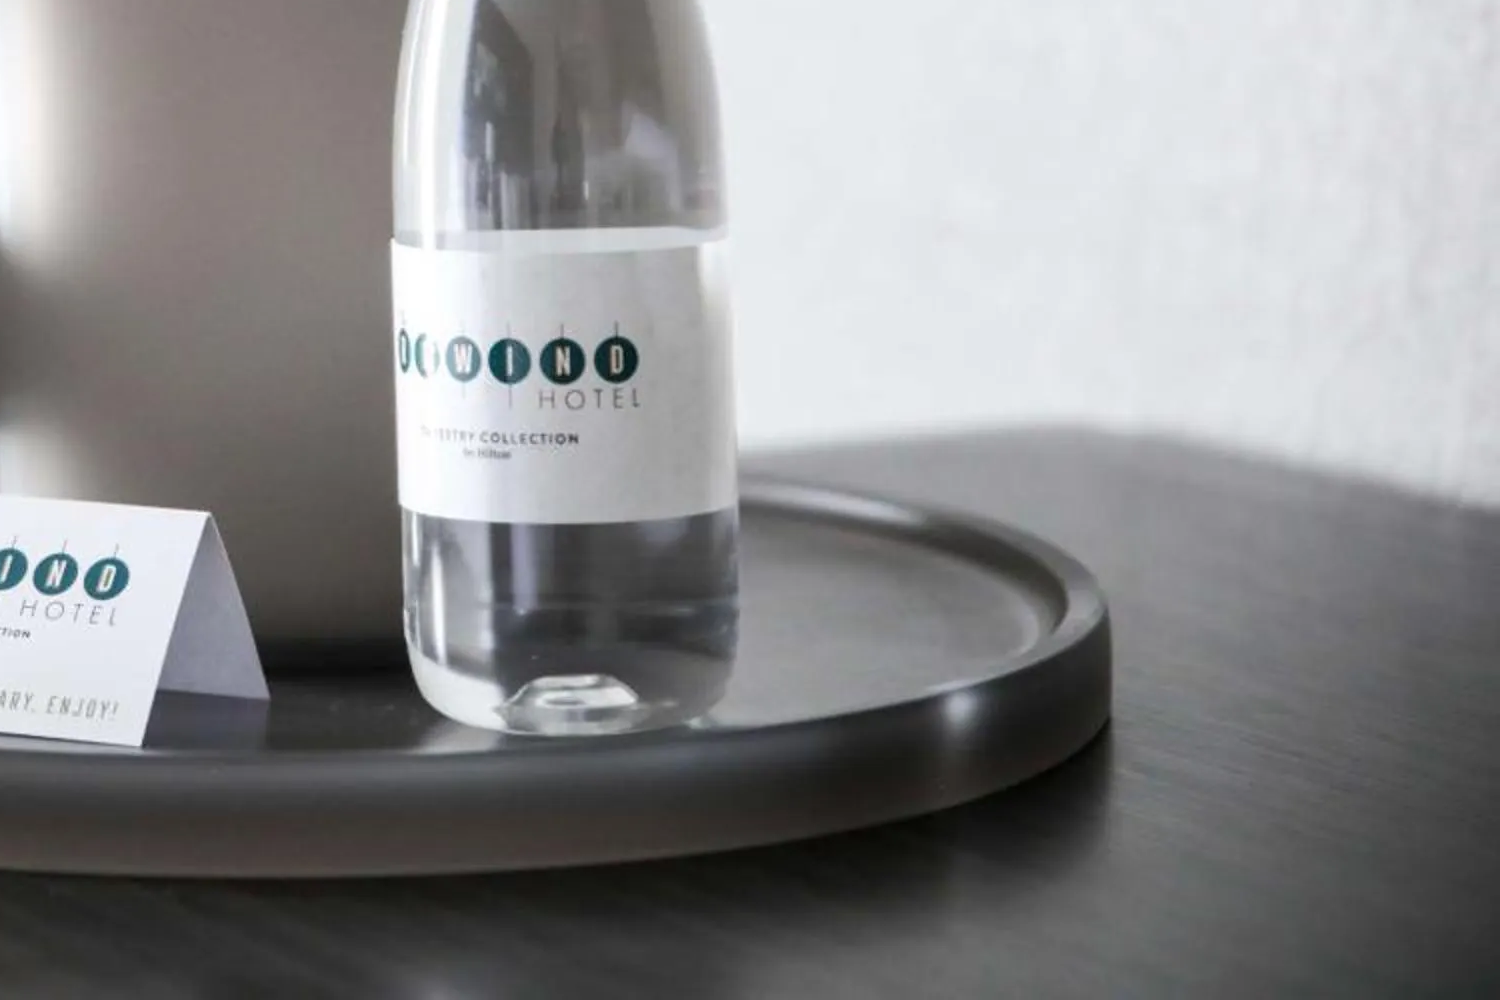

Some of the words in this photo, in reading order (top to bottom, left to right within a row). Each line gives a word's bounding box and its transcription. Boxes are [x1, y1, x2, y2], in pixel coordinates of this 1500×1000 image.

[538, 387, 642, 411] HOTEL
[479, 431, 579, 446] COLLECTION
[19, 598, 117, 627] HOTEL
[44, 694, 122, 722] ENJOY!
